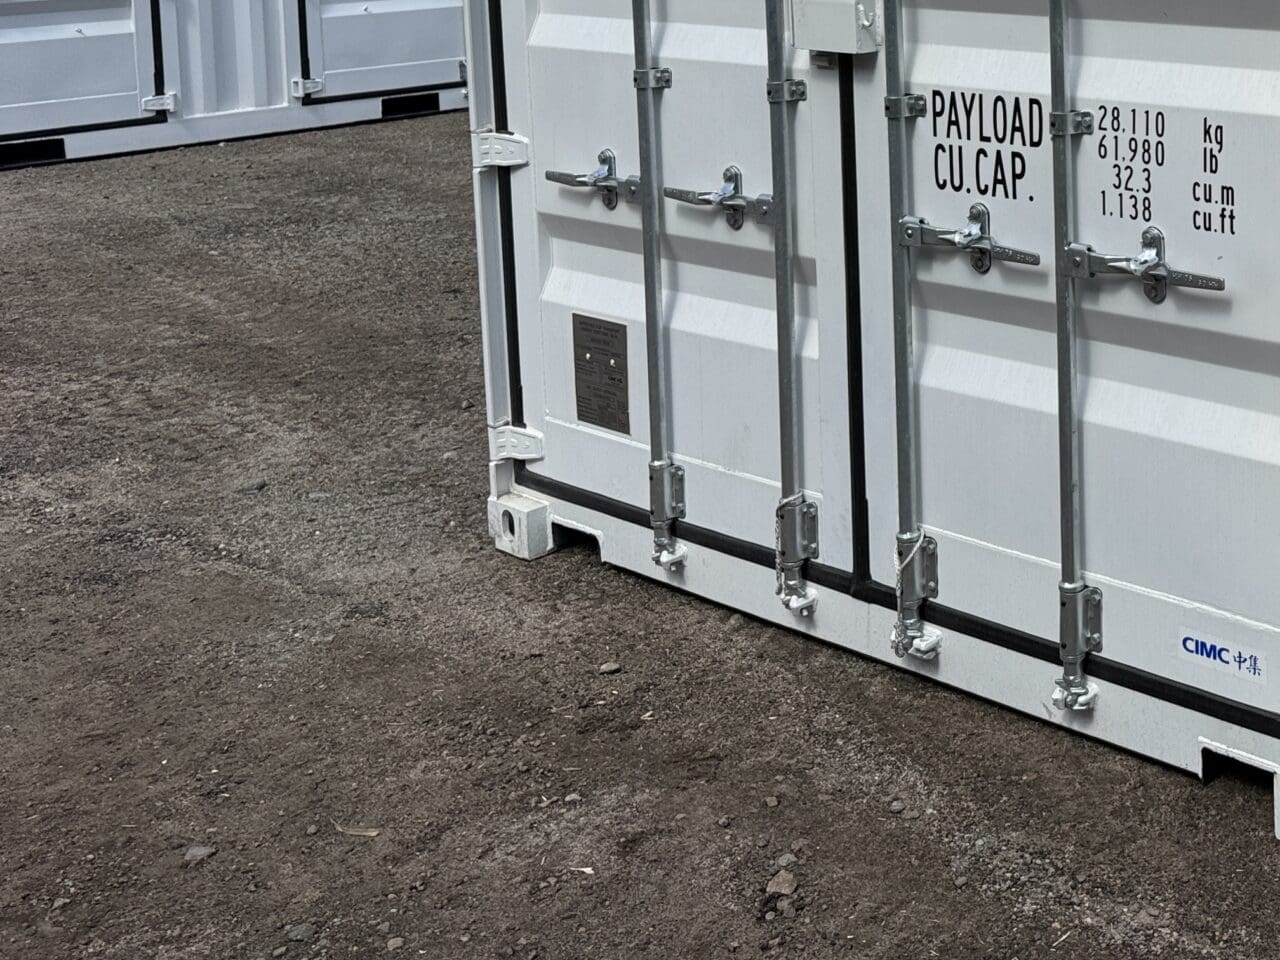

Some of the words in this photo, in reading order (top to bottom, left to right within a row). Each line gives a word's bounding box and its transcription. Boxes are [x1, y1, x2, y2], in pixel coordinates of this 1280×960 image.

[931, 90, 1043, 148] PAYLOAD
[1203, 117, 1223, 153] kg
[934, 143, 1034, 202] CU.CAP.
[1113, 164, 1151, 194] 32.3
[1192, 181, 1235, 207] cu.m
[1203, 147, 1218, 174] lb
[1192, 207, 1235, 235] cu.ft
[1182, 636, 1230, 665] CIMC
[1233, 651, 1262, 676] 中集
